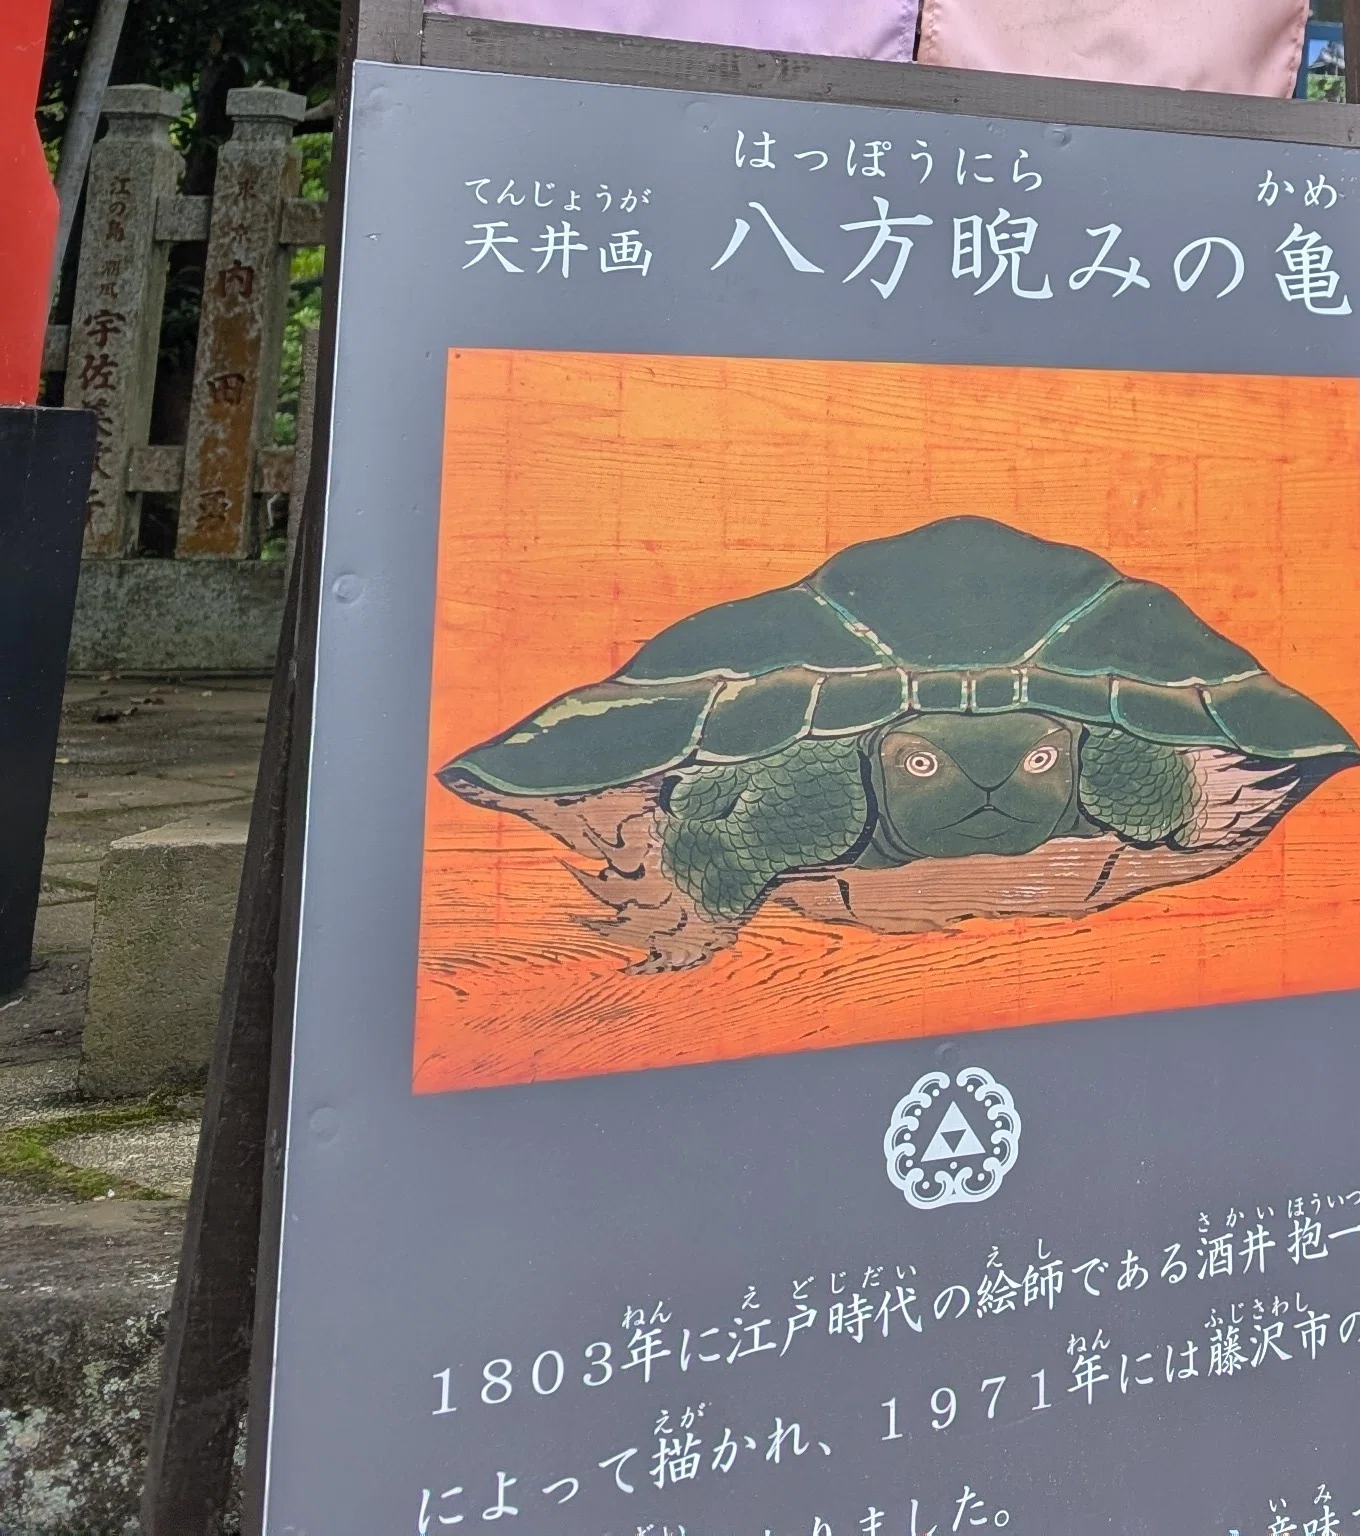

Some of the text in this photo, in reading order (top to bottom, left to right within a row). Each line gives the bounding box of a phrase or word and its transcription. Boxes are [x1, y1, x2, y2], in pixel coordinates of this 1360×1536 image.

[466, 178, 651, 214] てんじょうが
[736, 130, 1337, 208] はっぽうにら かめ
[462, 196, 1352, 316] 天井画 八方睨みの亀
[622, 1300, 672, 1330] ねん
[653, 1402, 706, 1435] えが
[1067, 1328, 1110, 1355] ねん
